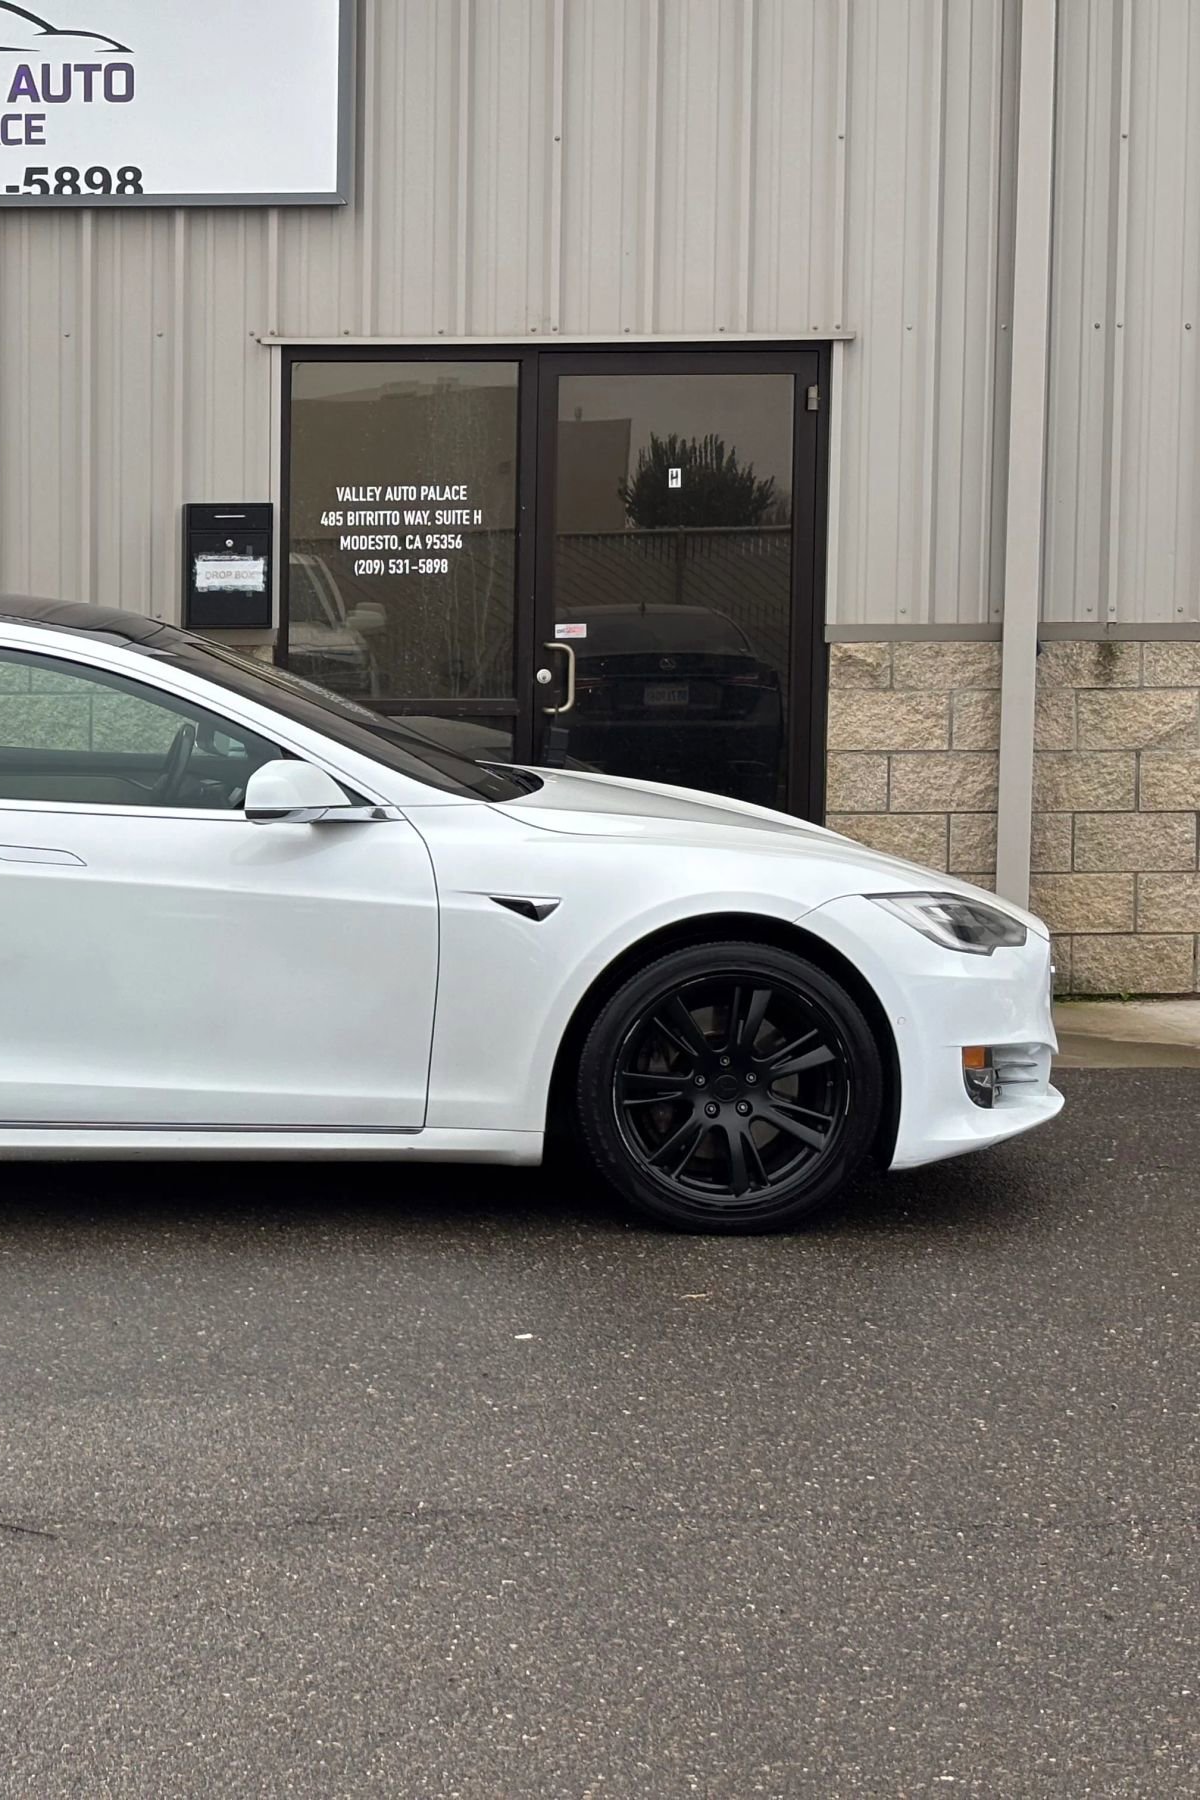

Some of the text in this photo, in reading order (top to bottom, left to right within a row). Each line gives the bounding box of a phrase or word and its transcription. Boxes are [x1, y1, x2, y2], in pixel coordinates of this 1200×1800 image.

[6, 62, 135, 103] AUTO
[336, 485, 468, 501] VALLEY AUTO PALACE
[320, 509, 482, 526] 485 BITRITTO WAY, SUITE H
[405, 535, 422, 550] CA
[425, 534, 463, 550] 95356
[205, 571, 232, 580] DROP
[354, 559, 448, 576] (209) 531-5898
